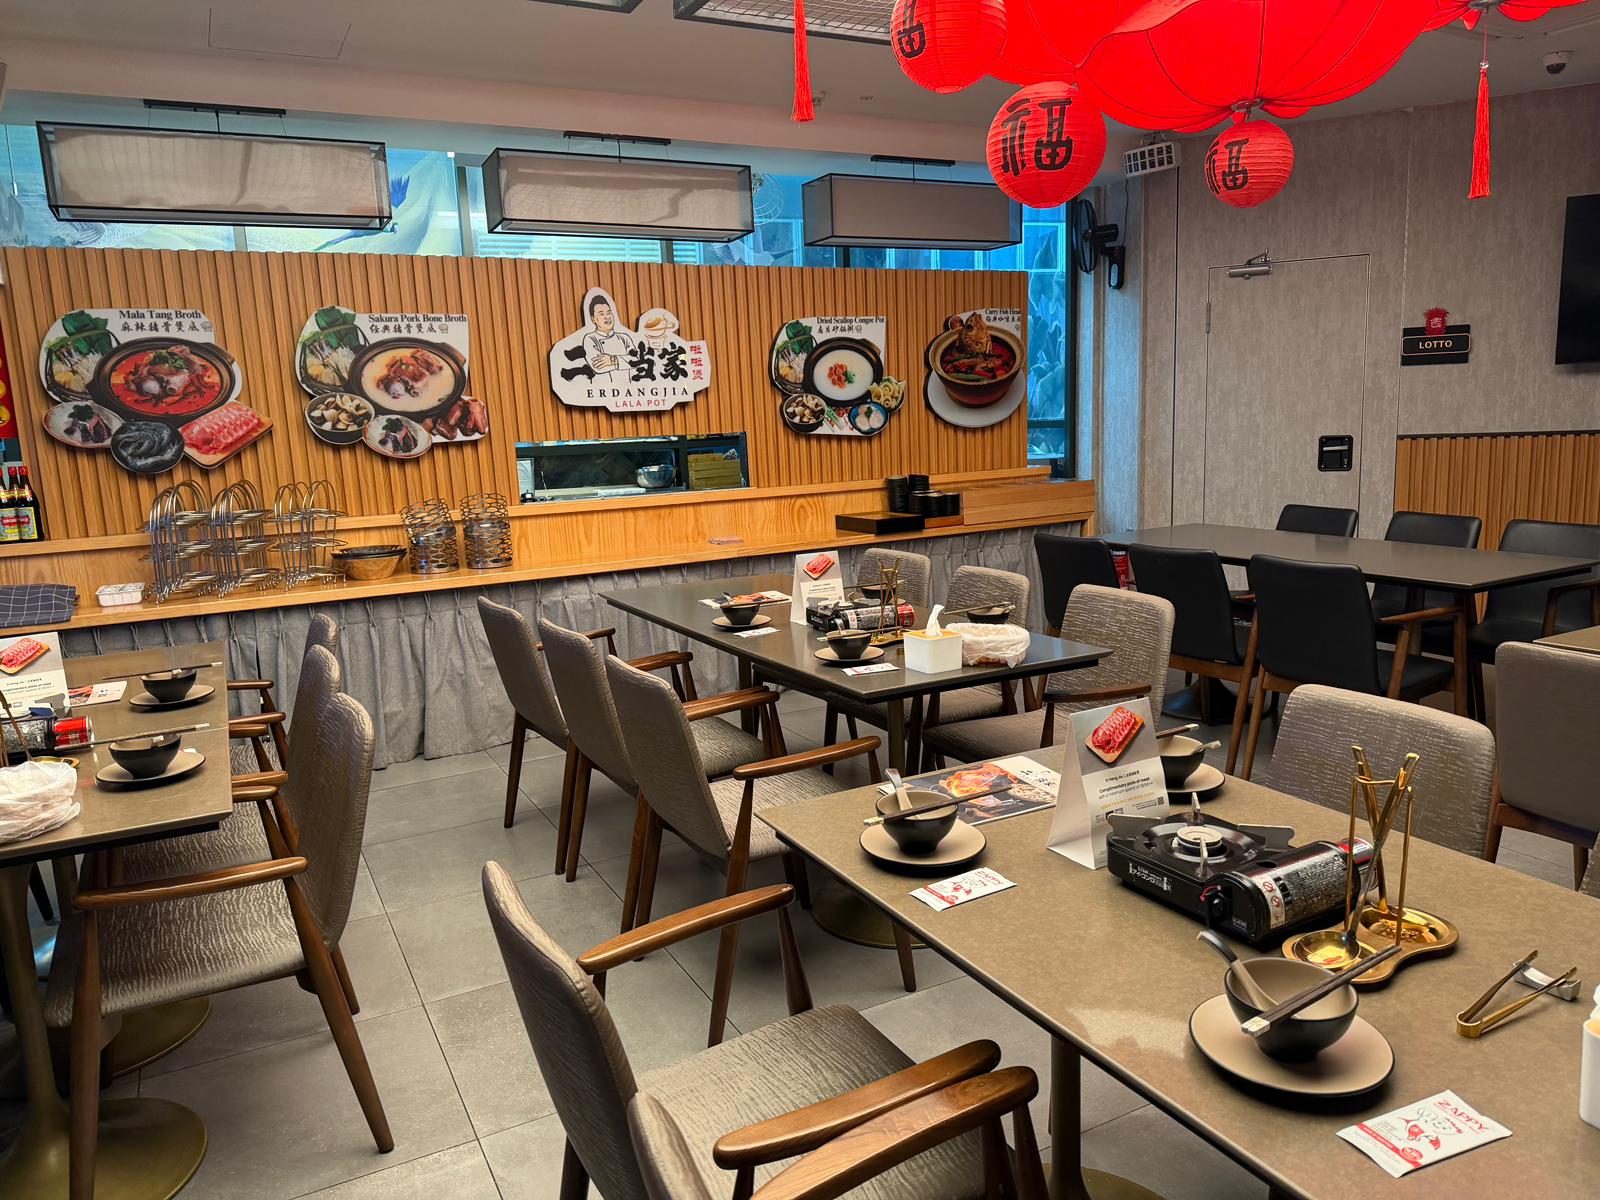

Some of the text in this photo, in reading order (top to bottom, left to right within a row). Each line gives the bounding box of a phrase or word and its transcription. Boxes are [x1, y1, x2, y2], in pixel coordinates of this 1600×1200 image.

[119, 310, 202, 320] Mala Tang Broth
[368, 314, 467, 323] Sakura Pork Bone Broth
[817, 316, 885, 326] Dried Scallop Congee Pot
[1419, 340, 1453, 349] LOTTO
[587, 387, 689, 398] ERDANGJIA
[615, 399, 667, 408] LALA POT
[1436, 1099, 1489, 1130] ZAPPY
